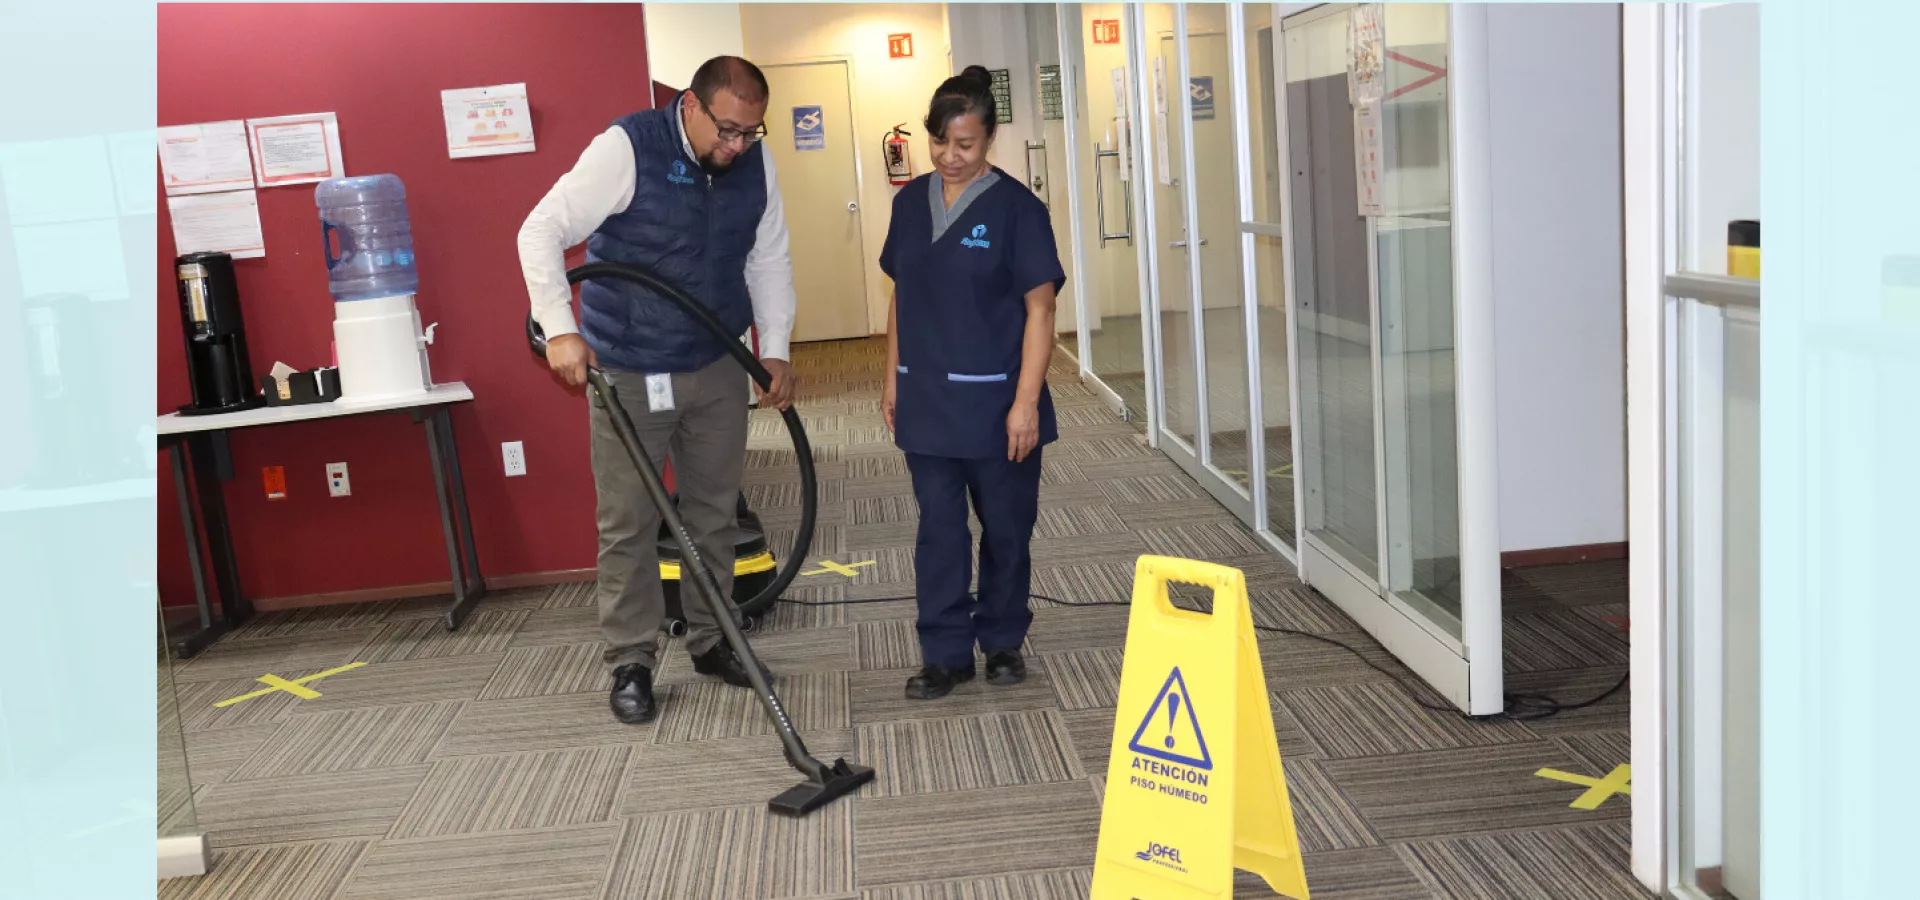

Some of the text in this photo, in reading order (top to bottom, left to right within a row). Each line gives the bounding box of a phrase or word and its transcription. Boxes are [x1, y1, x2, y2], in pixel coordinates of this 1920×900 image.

[1131, 757, 1209, 787] ATENCIÓN
[1130, 775, 1208, 805] PISO HÚMEDO
[1146, 841, 1182, 864] JOFEL
